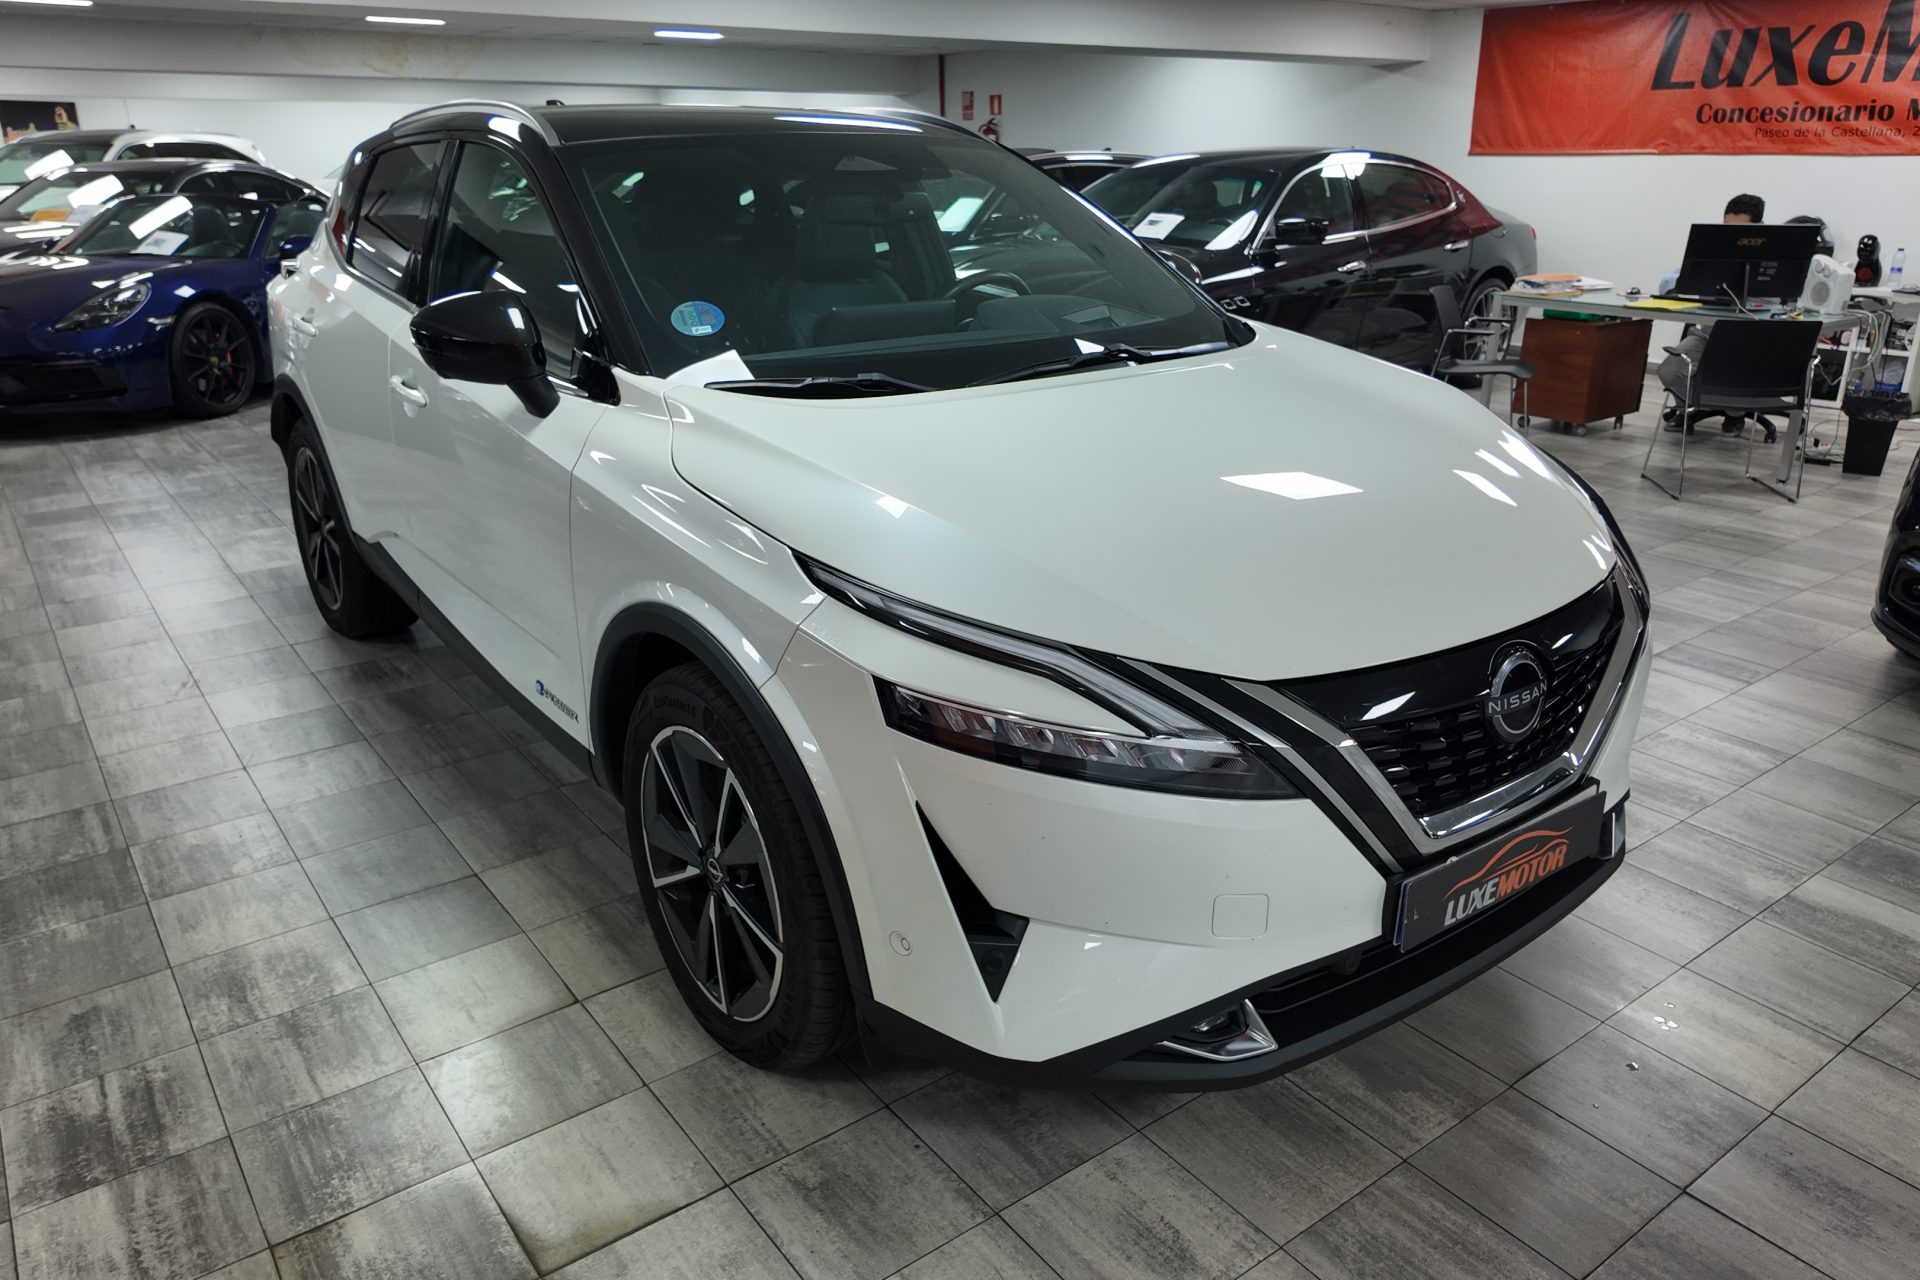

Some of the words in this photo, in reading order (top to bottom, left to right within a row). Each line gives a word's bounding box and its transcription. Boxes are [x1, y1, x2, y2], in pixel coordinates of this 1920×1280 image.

[1696, 99, 1895, 125] Concesionario
[1755, 127, 1790, 138] Paseo
[1793, 126, 1810, 138] de
[1814, 126, 1826, 138] la
[1831, 126, 1906, 138] Castellana,
[1488, 682, 1548, 714] NISSAN
[1444, 844, 1569, 927] LUXEMOTOR
